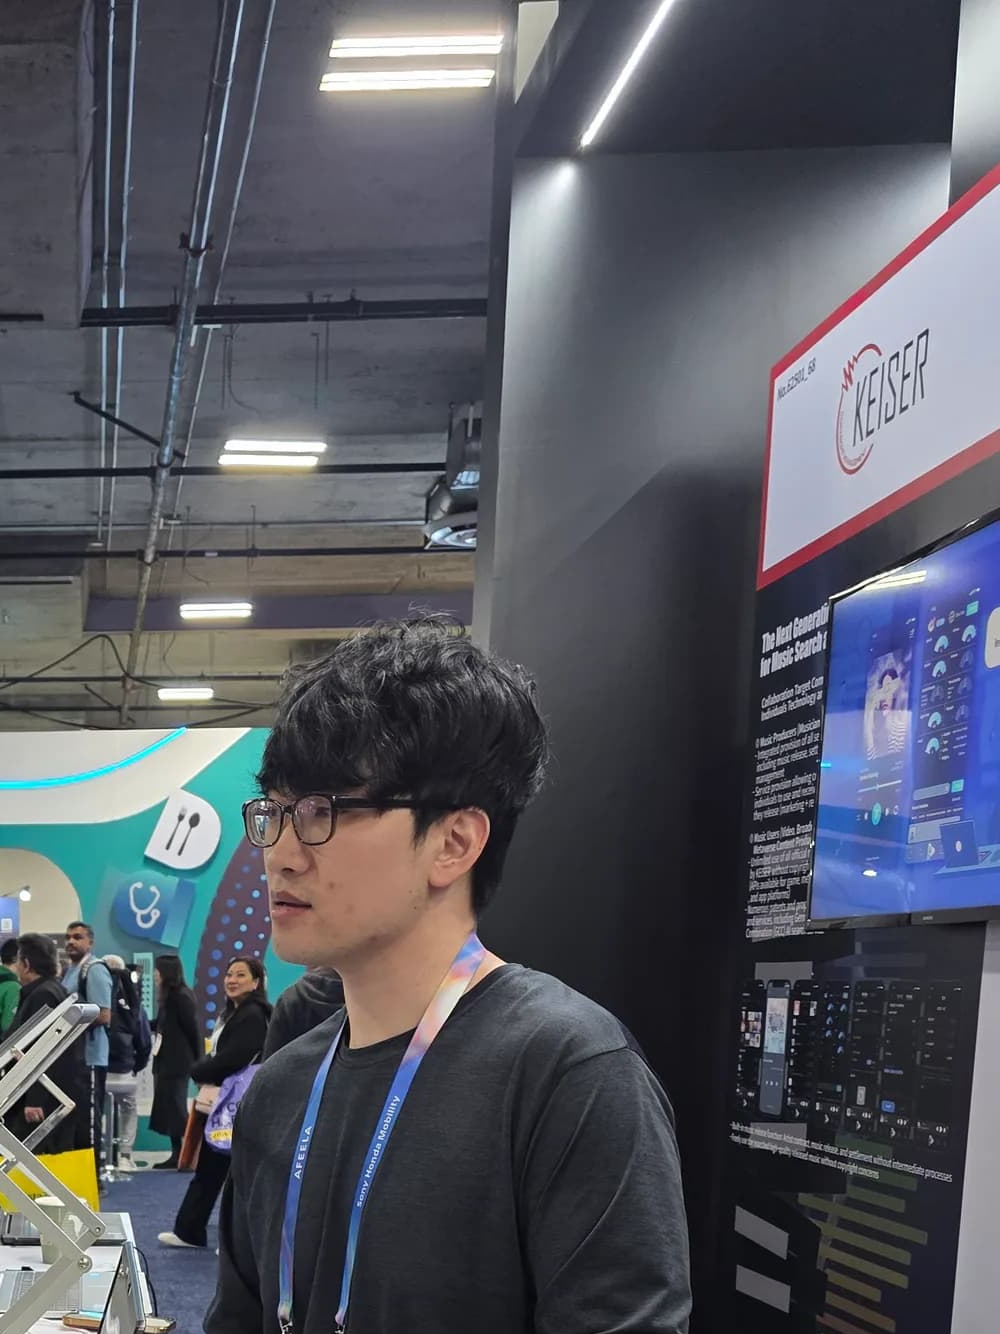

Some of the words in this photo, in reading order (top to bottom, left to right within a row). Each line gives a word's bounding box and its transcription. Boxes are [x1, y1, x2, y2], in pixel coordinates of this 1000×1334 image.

[853, 328, 929, 447] KEISER
[760, 657, 771, 678] for
[771, 645, 794, 672] Music
[795, 630, 823, 662] Search
[762, 632, 775, 654] The
[776, 621, 793, 648] Next
[762, 688, 794, 709] Collaboration
[795, 682, 811, 697] Target
[294, 1126, 312, 1179] AFEELA
[357, 1181, 369, 1207] Sony
[365, 1143, 382, 1178] Honda
[378, 1095, 401, 1141] Mobility
